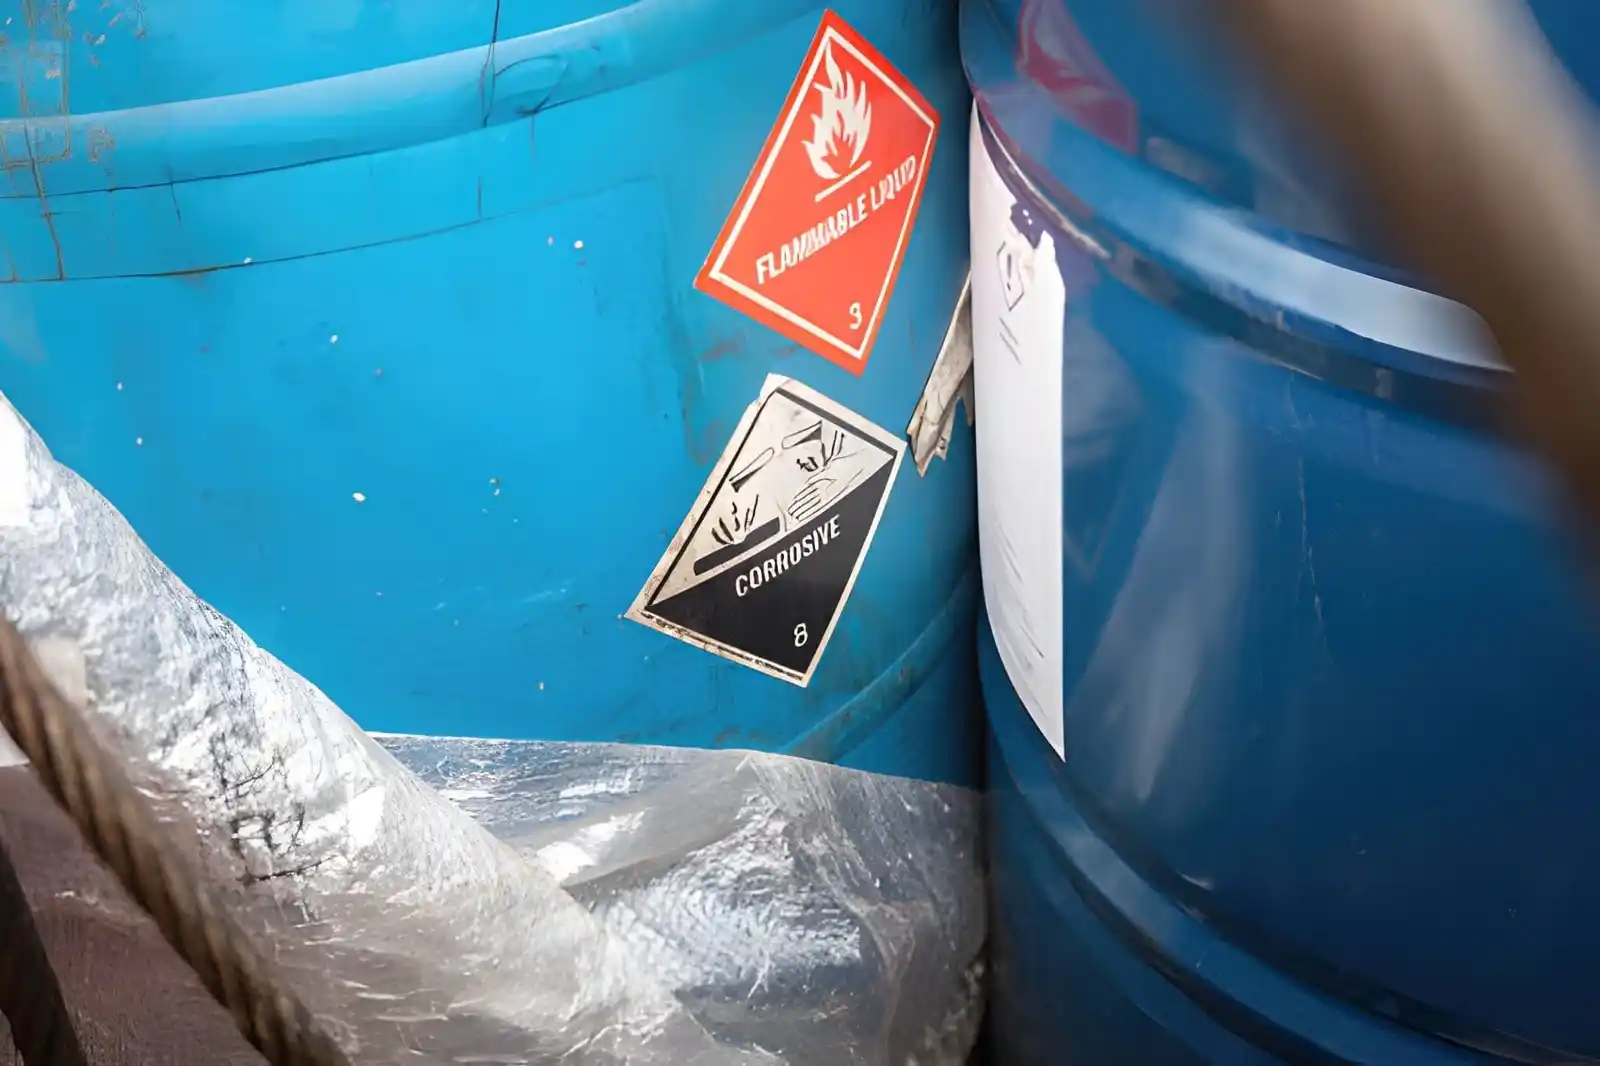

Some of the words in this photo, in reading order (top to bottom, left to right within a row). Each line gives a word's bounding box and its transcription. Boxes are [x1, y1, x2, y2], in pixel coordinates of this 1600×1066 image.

[756, 194, 868, 285] FLAMMABLE
[870, 155, 917, 211] LIQUID
[735, 514, 841, 597] CORROSIVE
[794, 623, 808, 647] 8
